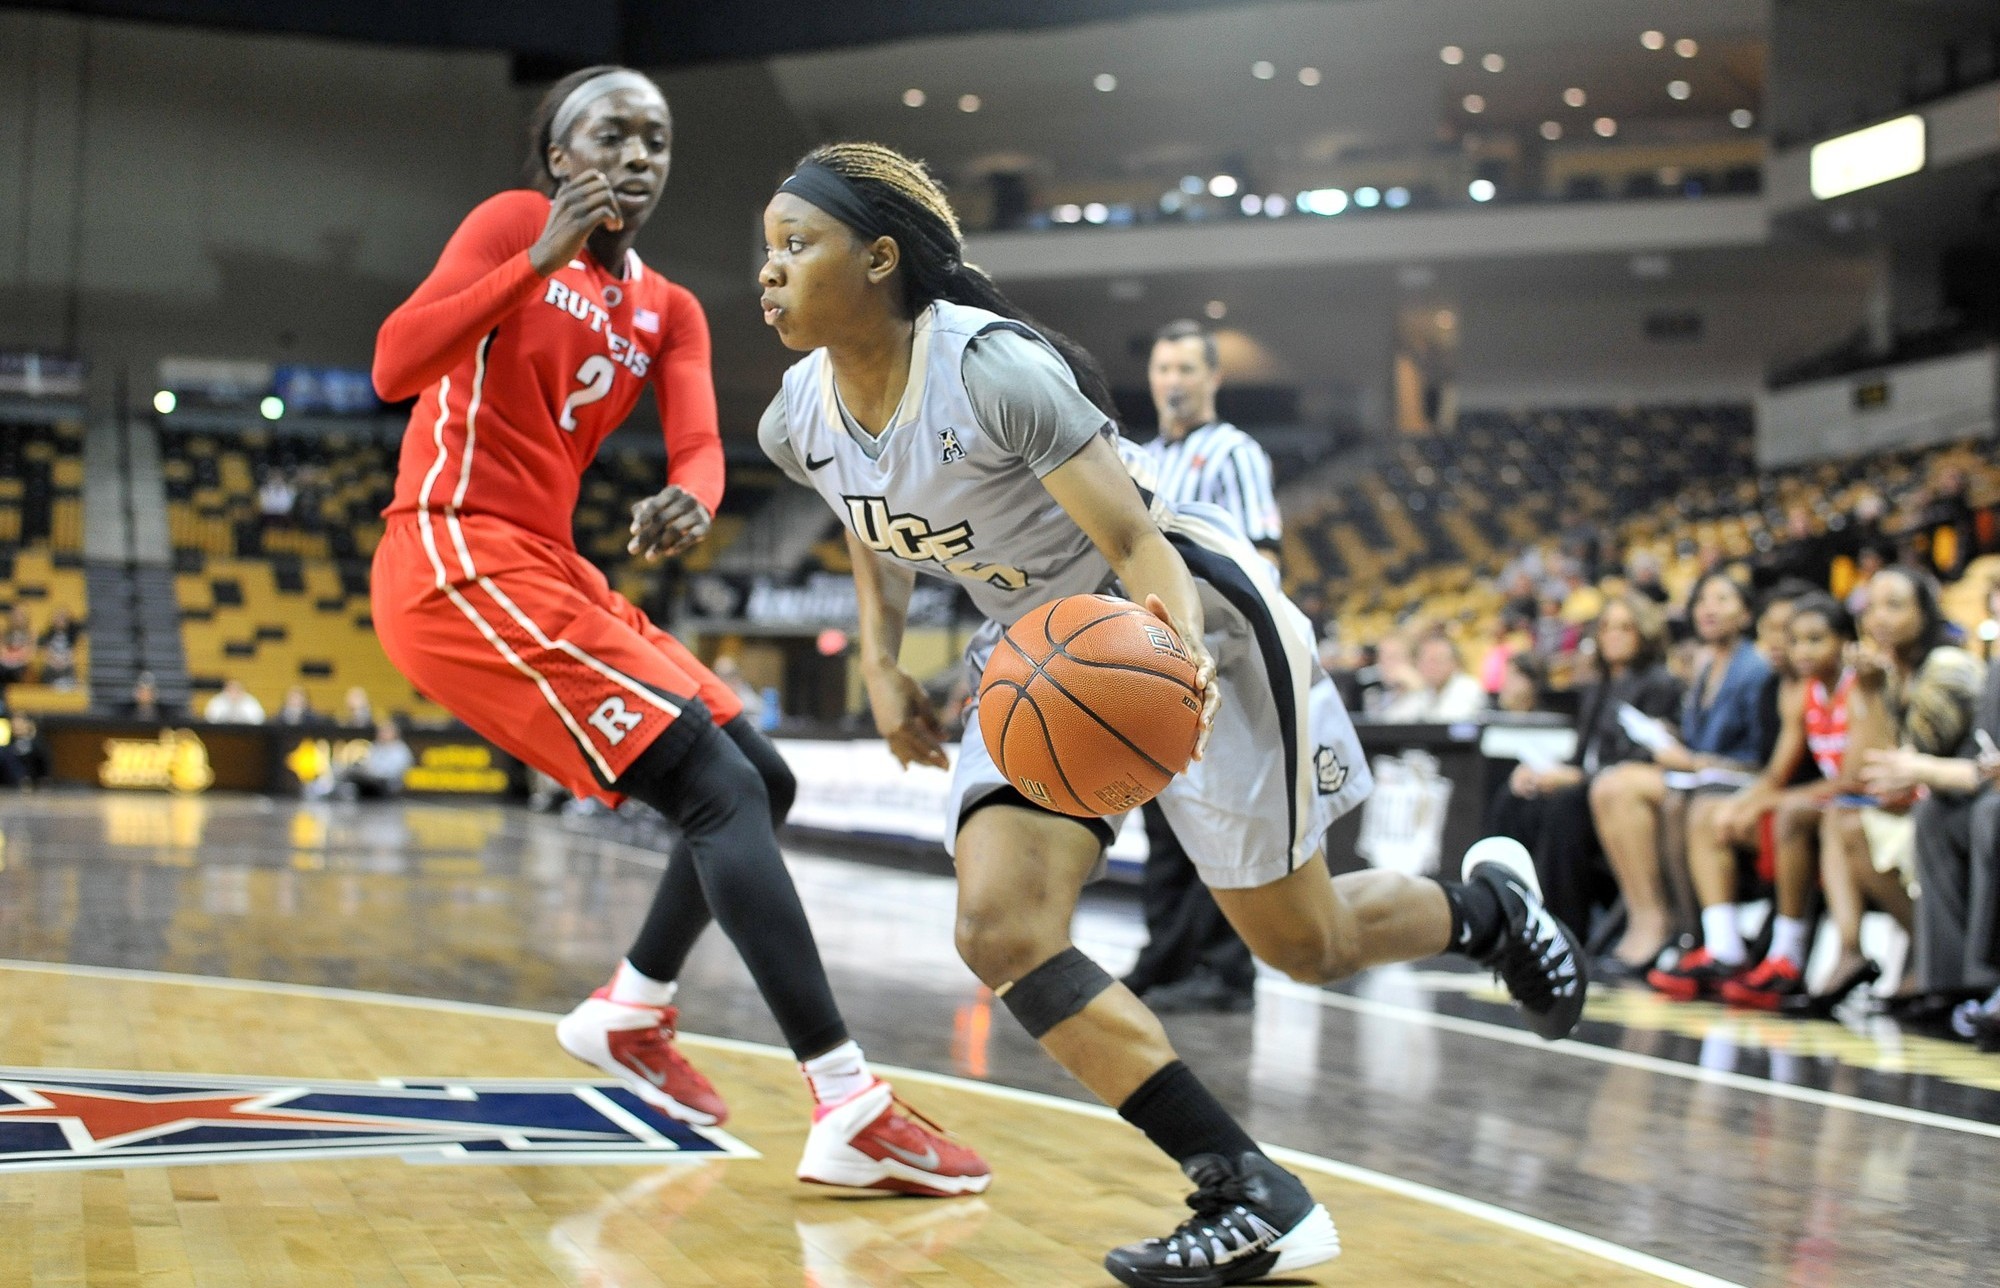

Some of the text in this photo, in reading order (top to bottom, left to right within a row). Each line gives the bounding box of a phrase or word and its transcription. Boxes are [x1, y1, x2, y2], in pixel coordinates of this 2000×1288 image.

[559, 354, 616, 432] 2
[840, 493, 975, 562] UCF
[587, 695, 643, 746] R
